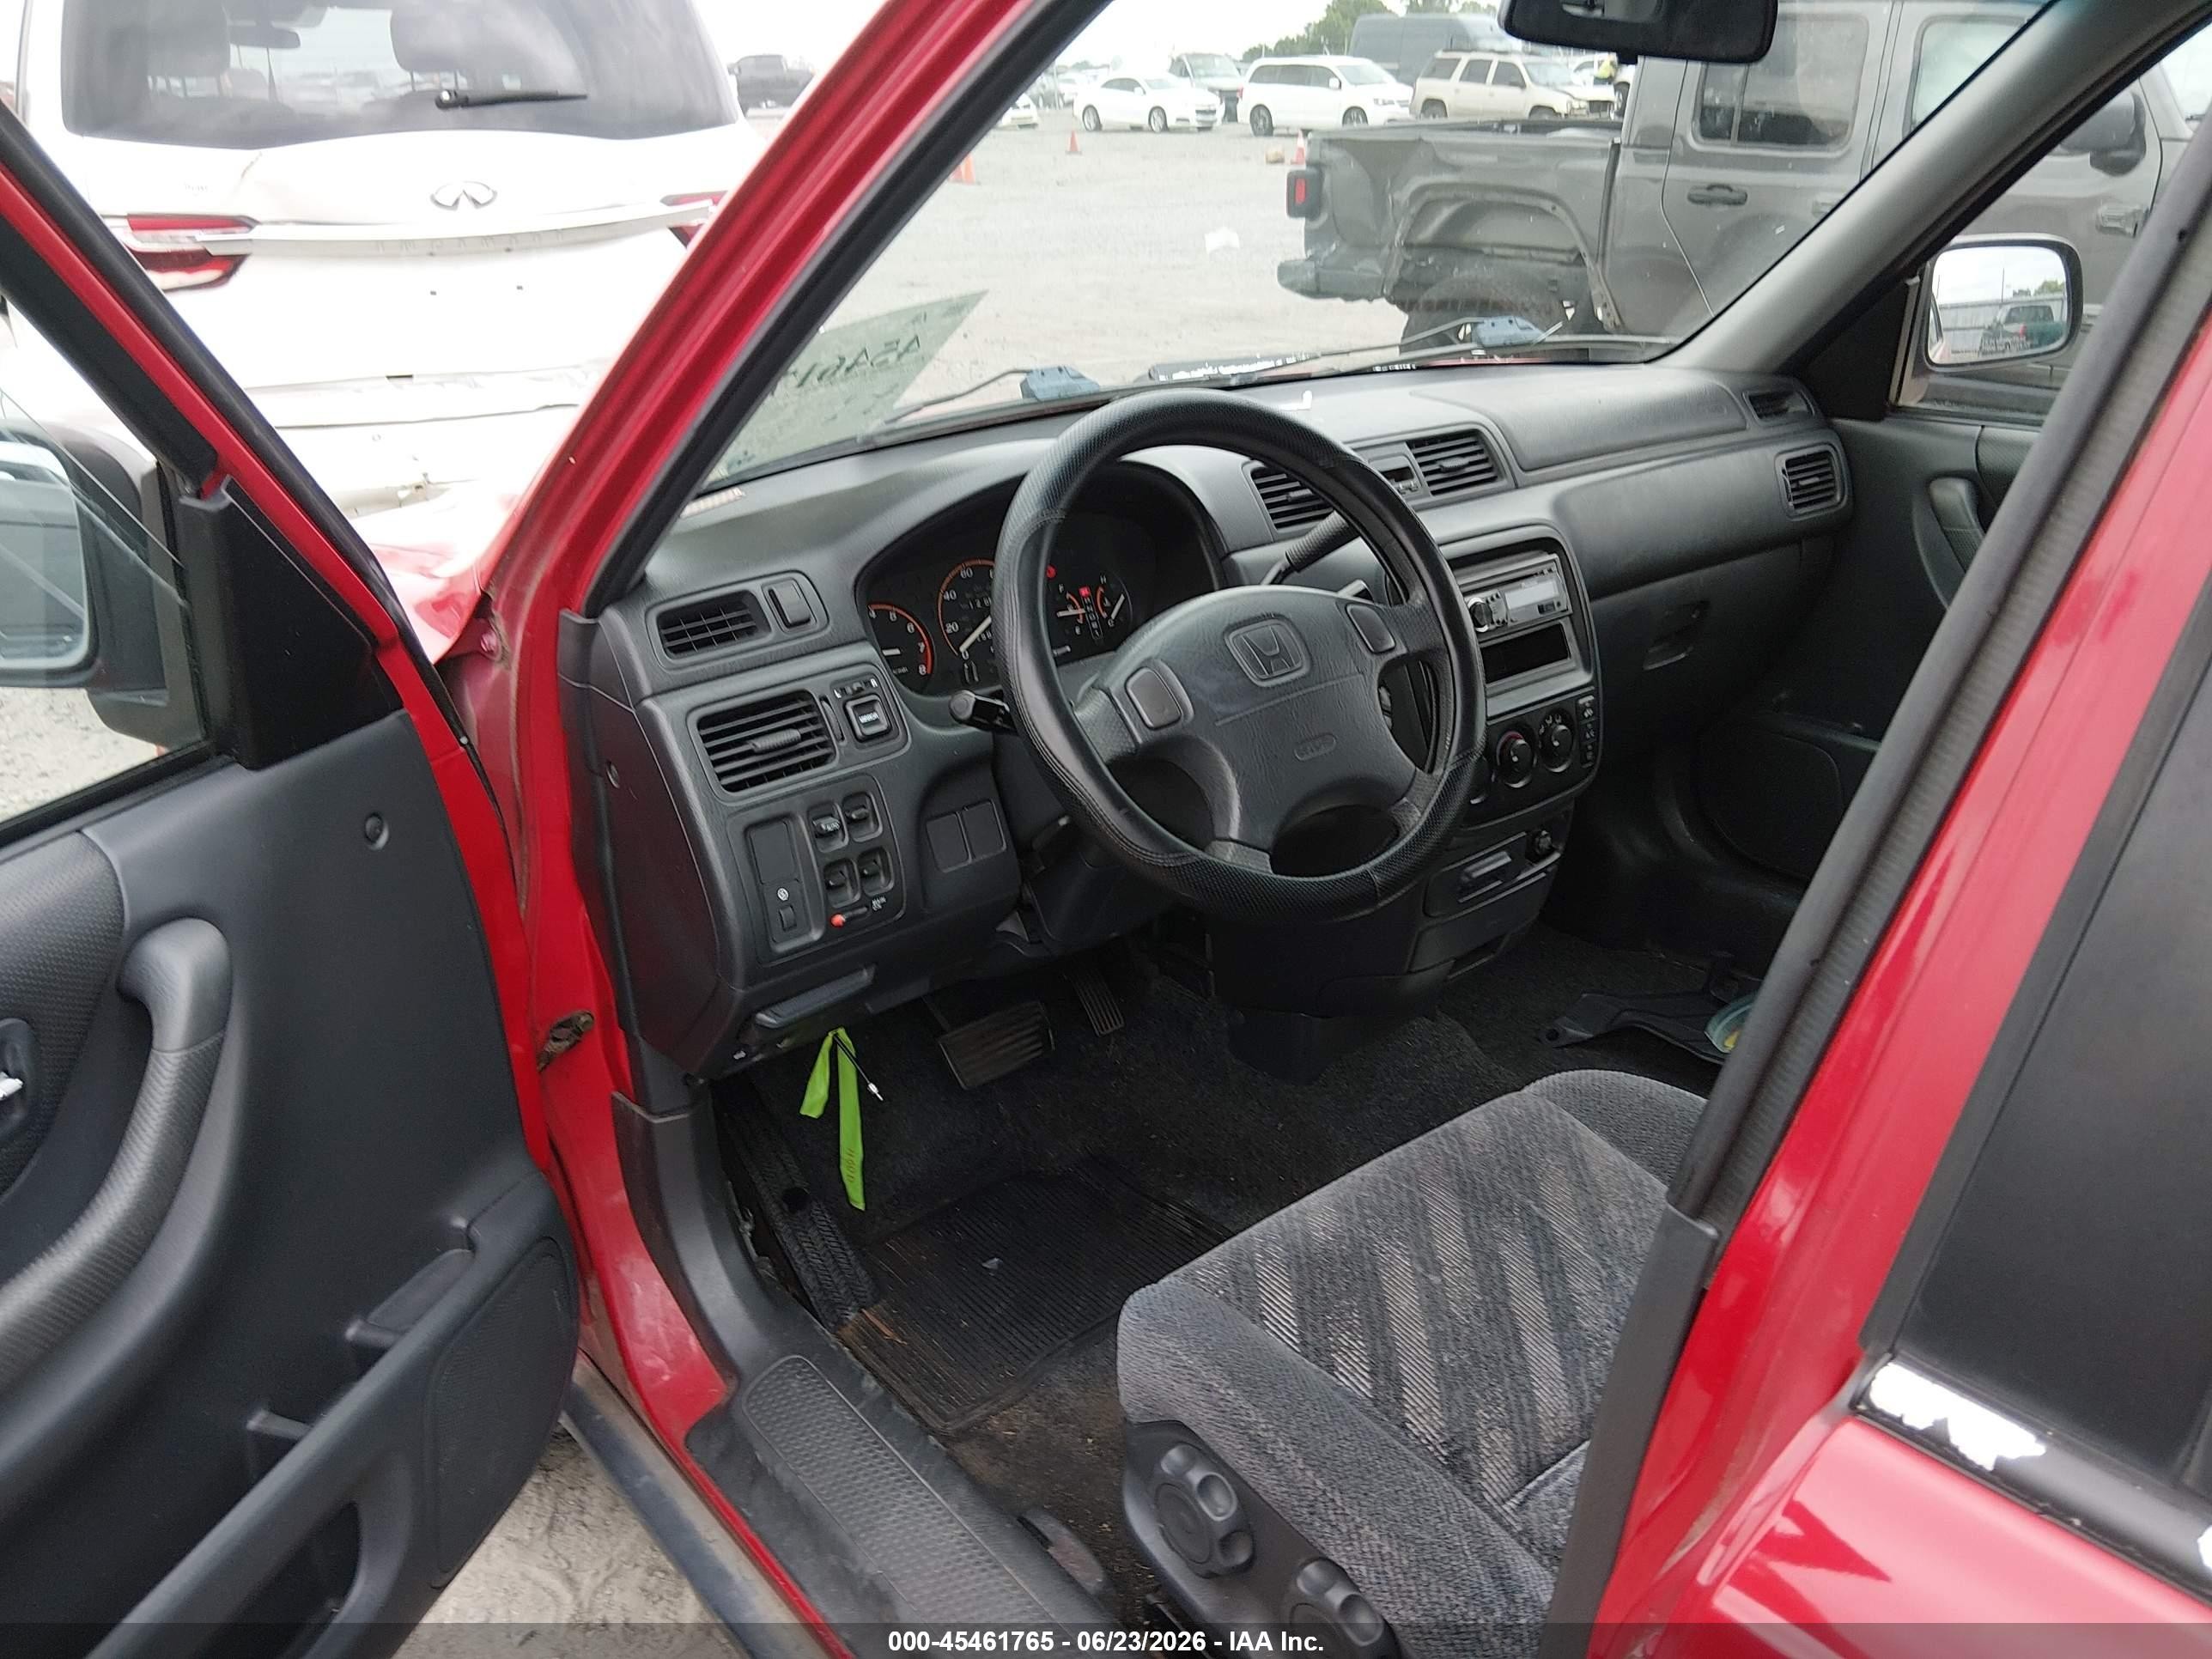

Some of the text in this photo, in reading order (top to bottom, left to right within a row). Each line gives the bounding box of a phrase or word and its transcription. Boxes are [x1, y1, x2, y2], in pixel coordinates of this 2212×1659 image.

[943, 589, 957, 601] 40
[907, 622, 915, 634] 6
[945, 621, 959, 634] 20
[961, 650, 969, 660] 0
[918, 664, 927, 675] 8
